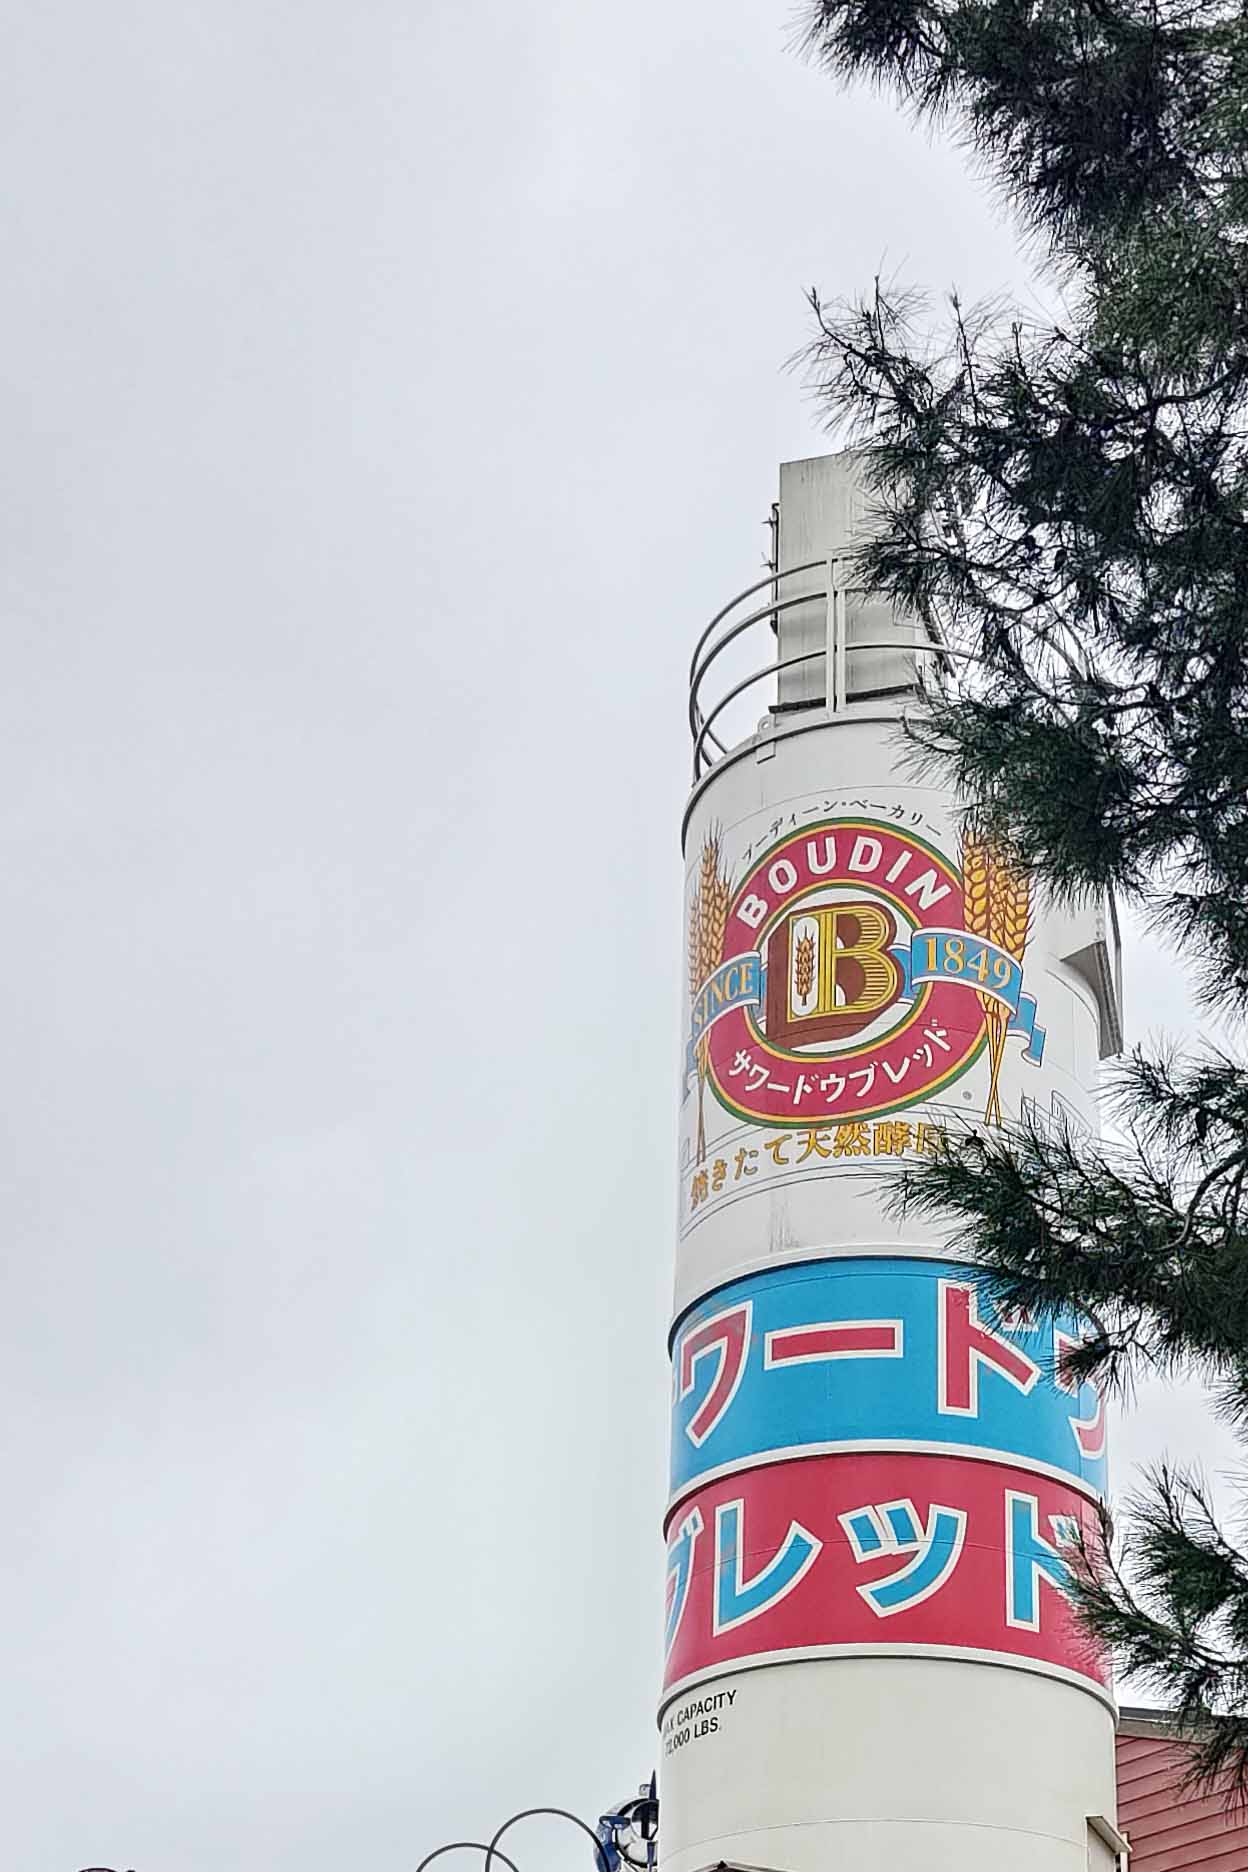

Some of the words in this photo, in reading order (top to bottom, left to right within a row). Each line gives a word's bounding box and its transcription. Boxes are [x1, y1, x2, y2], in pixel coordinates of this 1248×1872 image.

[737, 834, 951, 929] BOUDIN
[693, 962, 754, 1026] SINCE
[924, 936, 1013, 991] 1849
[728, 1018, 954, 1106] サワードウブレッド
[677, 1689, 737, 1726] CAPACITY
